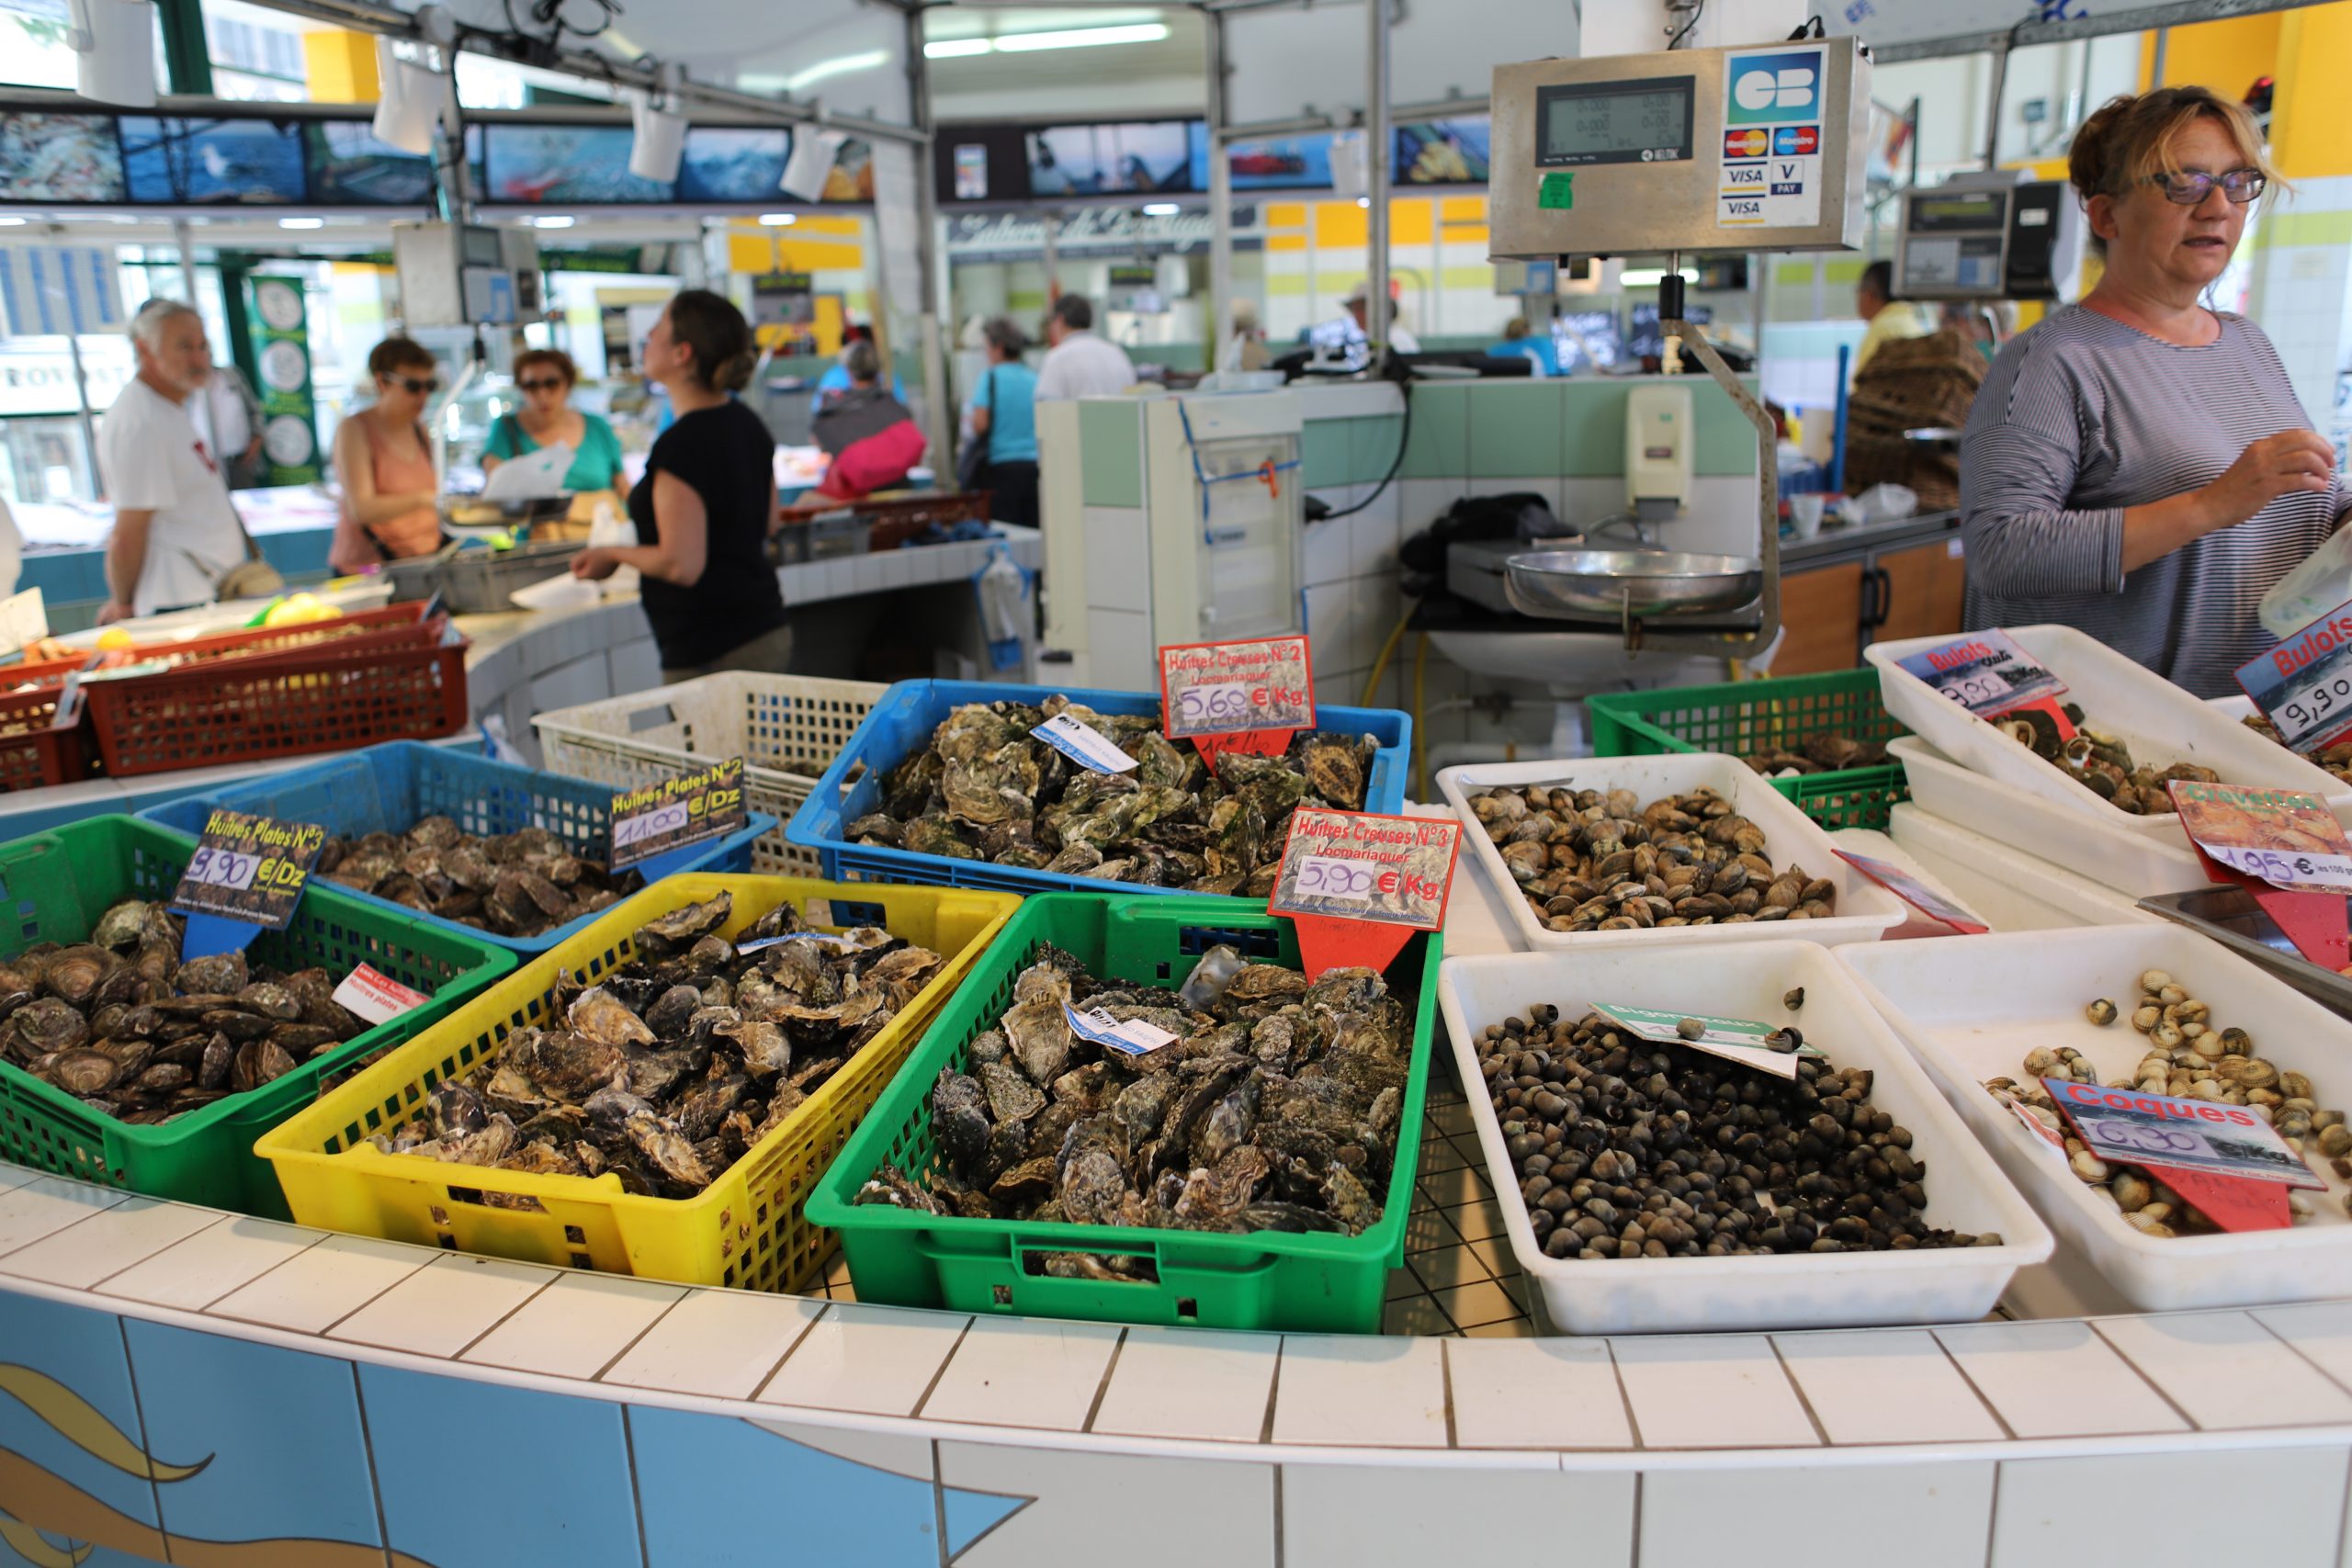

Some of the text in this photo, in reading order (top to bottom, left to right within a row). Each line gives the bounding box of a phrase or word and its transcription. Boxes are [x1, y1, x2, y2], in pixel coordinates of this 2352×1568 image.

[1735, 68, 1815, 110] CB
[1777, 136, 1815, 147] Maestro
[1729, 170, 1763, 183] VISA
[1781, 164, 1794, 179] V
[1777, 184, 1796, 194] PAY
[1728, 202, 1759, 214] VISA
[1217, 650, 1269, 667] Creuses
[1926, 641, 1993, 671] Bulots
[1191, 671, 1272, 685] Locmariaquer
[1181, 689, 1247, 717] 5,60
[2286, 680, 2350, 728] 9,90
[665, 774, 709, 796] Plates
[2186, 783, 2318, 810] Crevettes
[617, 809, 683, 844] 11,00
[688, 788, 741, 816] €/Dz
[252, 821, 293, 848] Plates
[1296, 816, 1350, 840] Huîtres
[1353, 821, 1412, 845] Creuses
[1316, 844, 1411, 863] Locmariaquer
[2293, 858, 2314, 875] €
[258, 856, 307, 887] €/Dz
[1299, 861, 1439, 901] 5,90 €/Kg
[2067, 1085, 2256, 1127] Coques
